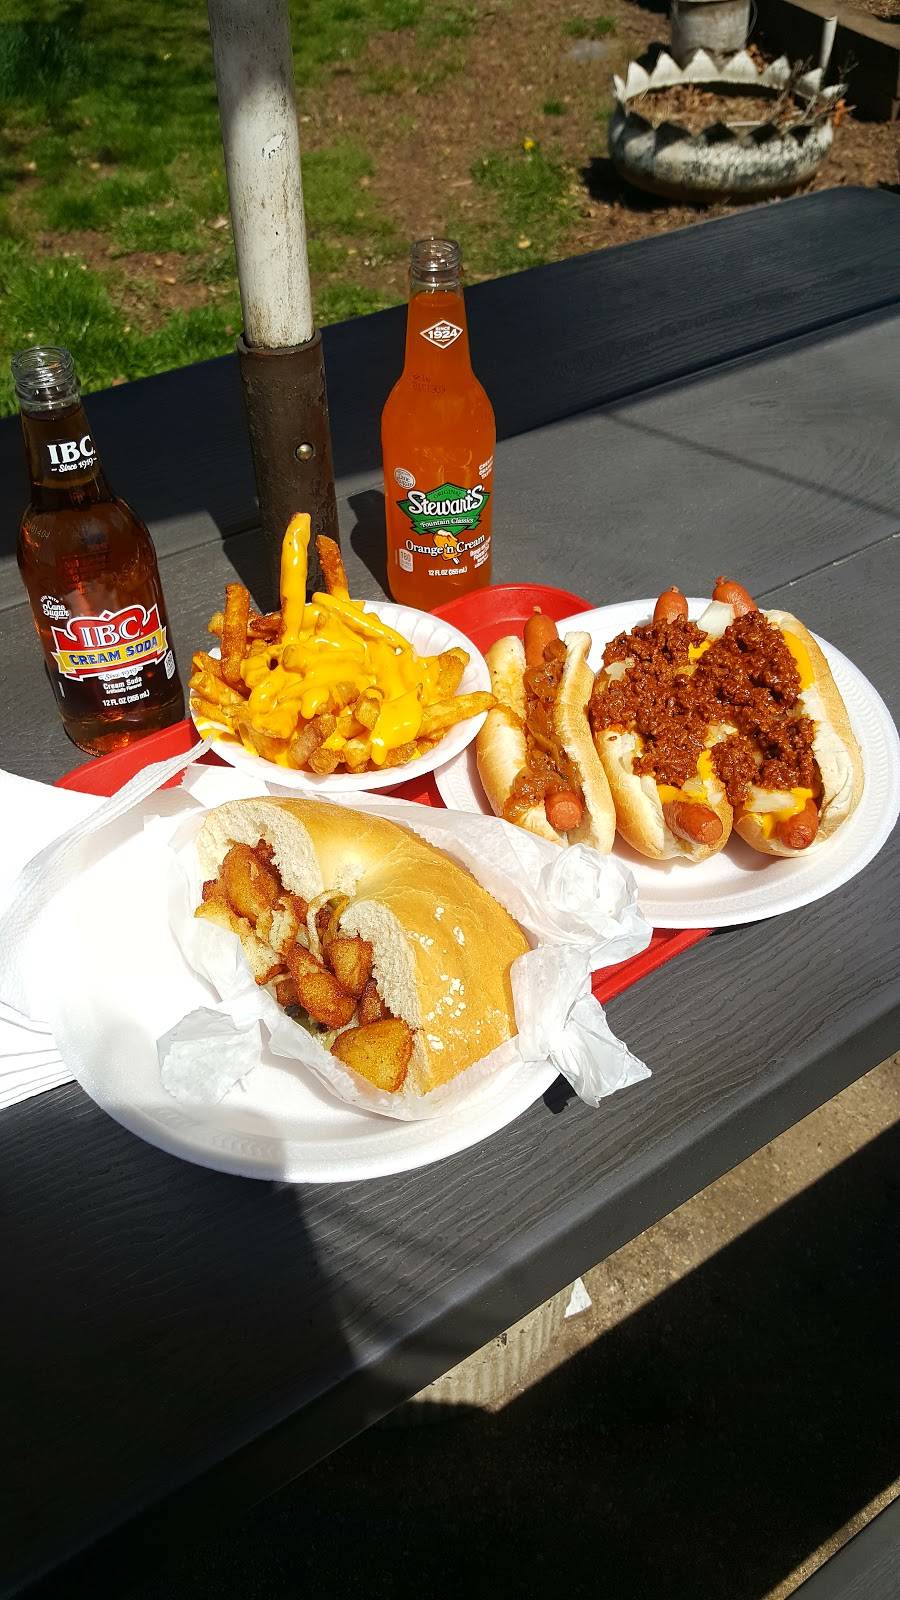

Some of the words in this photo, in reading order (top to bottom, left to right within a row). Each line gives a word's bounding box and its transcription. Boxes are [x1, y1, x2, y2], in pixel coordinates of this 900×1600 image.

[428, 329, 458, 339] 1924
[47, 435, 94, 465] IBC
[58, 464, 78, 473] Since
[78, 457, 93, 470] 1919
[420, 519, 450, 528] Fountain
[405, 540, 443, 557] Orange
[456, 534, 485, 553] Cream
[42, 600, 66, 611] Cane
[43, 609, 70, 621] Sugar
[79, 616, 141, 648] IBC
[68, 649, 121, 666] CREAM
[125, 635, 159, 658] SODA
[103, 682, 125, 690] Cream
[125, 676, 143, 686] Soda
